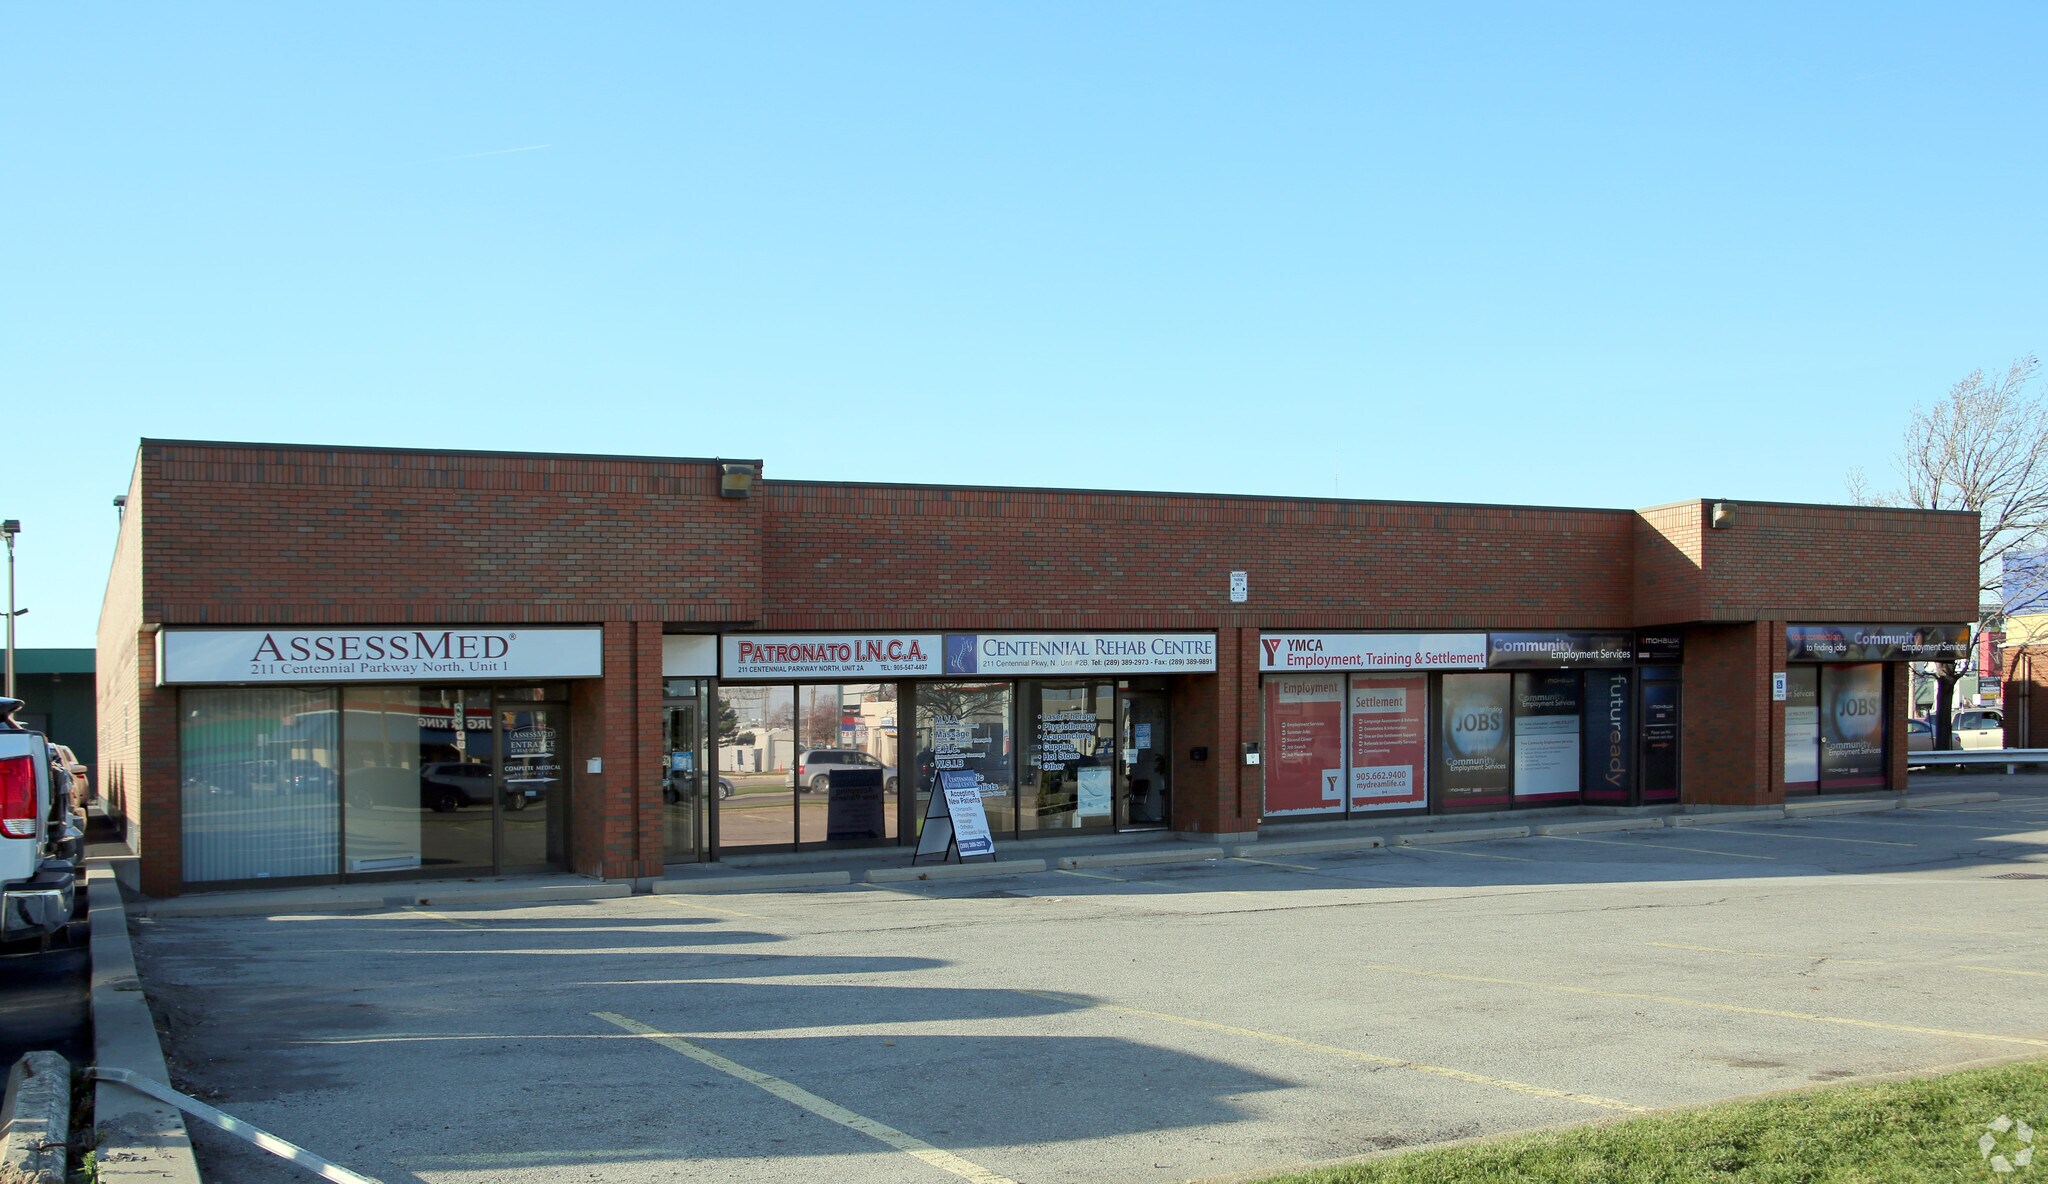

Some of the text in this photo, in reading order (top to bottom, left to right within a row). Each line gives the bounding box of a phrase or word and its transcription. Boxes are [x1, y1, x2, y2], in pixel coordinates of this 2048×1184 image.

[1790, 633, 1806, 641] Your
[982, 638, 1212, 656] CENTENNIAL REHAB CENTRE
[1287, 639, 1324, 652] YMCA
[1854, 632, 1967, 654] Community Employment Services
[738, 640, 929, 663] PATRONATO I.N.C.A.
[1493, 639, 1574, 653] Community
[1551, 649, 1599, 662] Employment
[1600, 648, 1631, 659] Services
[1814, 643, 1832, 654] finding
[1832, 643, 1846, 653] jobs
[1031, 660, 1049, 668] Pkwy,
[1104, 659, 1120, 667] (289)
[1168, 658, 1184, 666] (289)
[1287, 652, 1485, 668] Employment, Training & Settlement
[251, 661, 509, 675] 211 Centennial Parkway North, Unit 1
[1284, 682, 1338, 695] Employment
[1356, 696, 1403, 708] Settlement
[1840, 698, 1877, 716] JOBS
[1065, 713, 1096, 722] Therapy
[1042, 722, 1096, 732] Physiotherapy
[1456, 714, 1500, 732] JOBS
[1606, 674, 1626, 786] futuready
[936, 731, 970, 740] Massage
[1042, 732, 1091, 742] Acupuncture
[1042, 742, 1075, 752] Cupping
[1824, 740, 1872, 750] Community
[1042, 752, 1080, 760] Hot Stone
[1828, 748, 1860, 758] Employment
[1042, 762, 1065, 770] Other
[1446, 756, 1496, 766] Community
[1450, 764, 1484, 772] Employment
[1356, 770, 1406, 781] 905.662.9400
[1356, 780, 1406, 790] mydreamlife.ca
